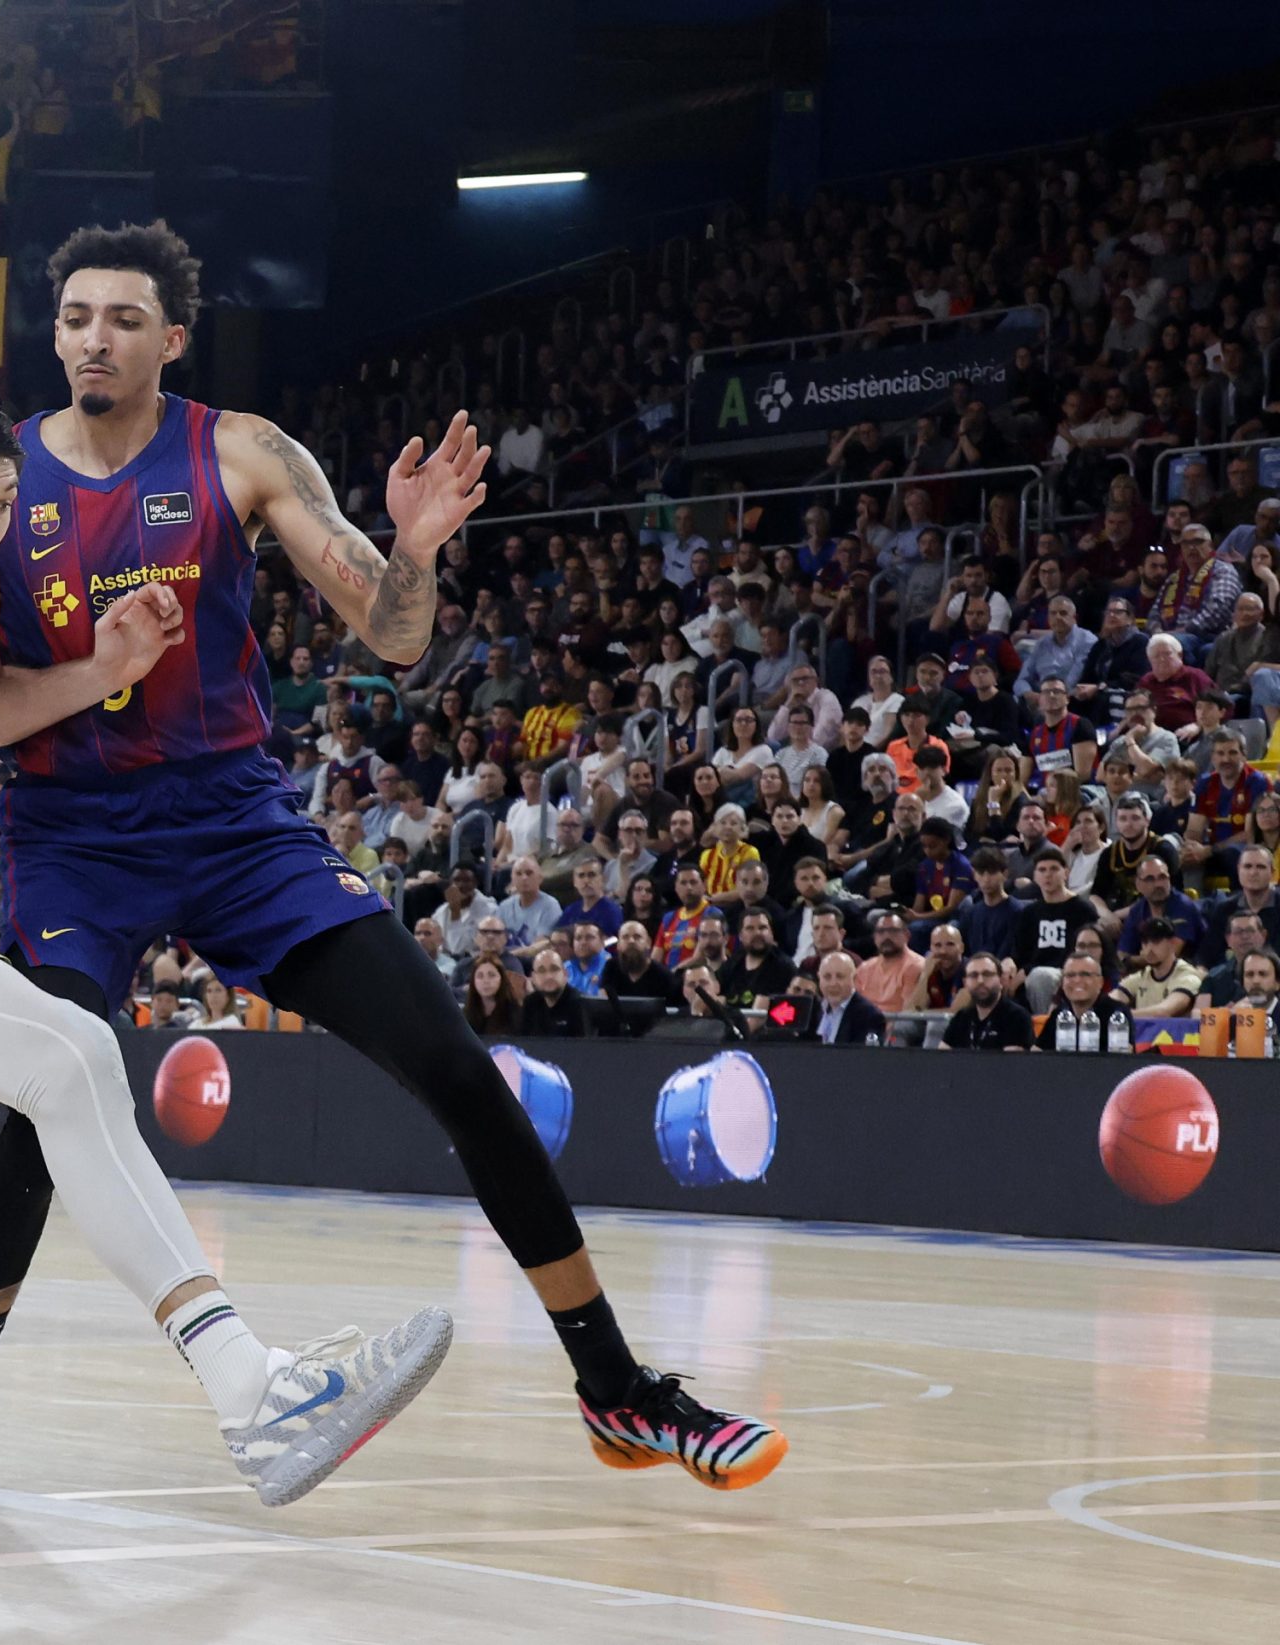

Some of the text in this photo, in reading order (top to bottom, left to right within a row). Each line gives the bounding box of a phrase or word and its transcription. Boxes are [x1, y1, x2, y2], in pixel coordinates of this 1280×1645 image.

[717, 377, 749, 428] A
[149, 503, 168, 514] liga
[150, 510, 189, 521] endesa
[89, 560, 201, 595] Assistència
